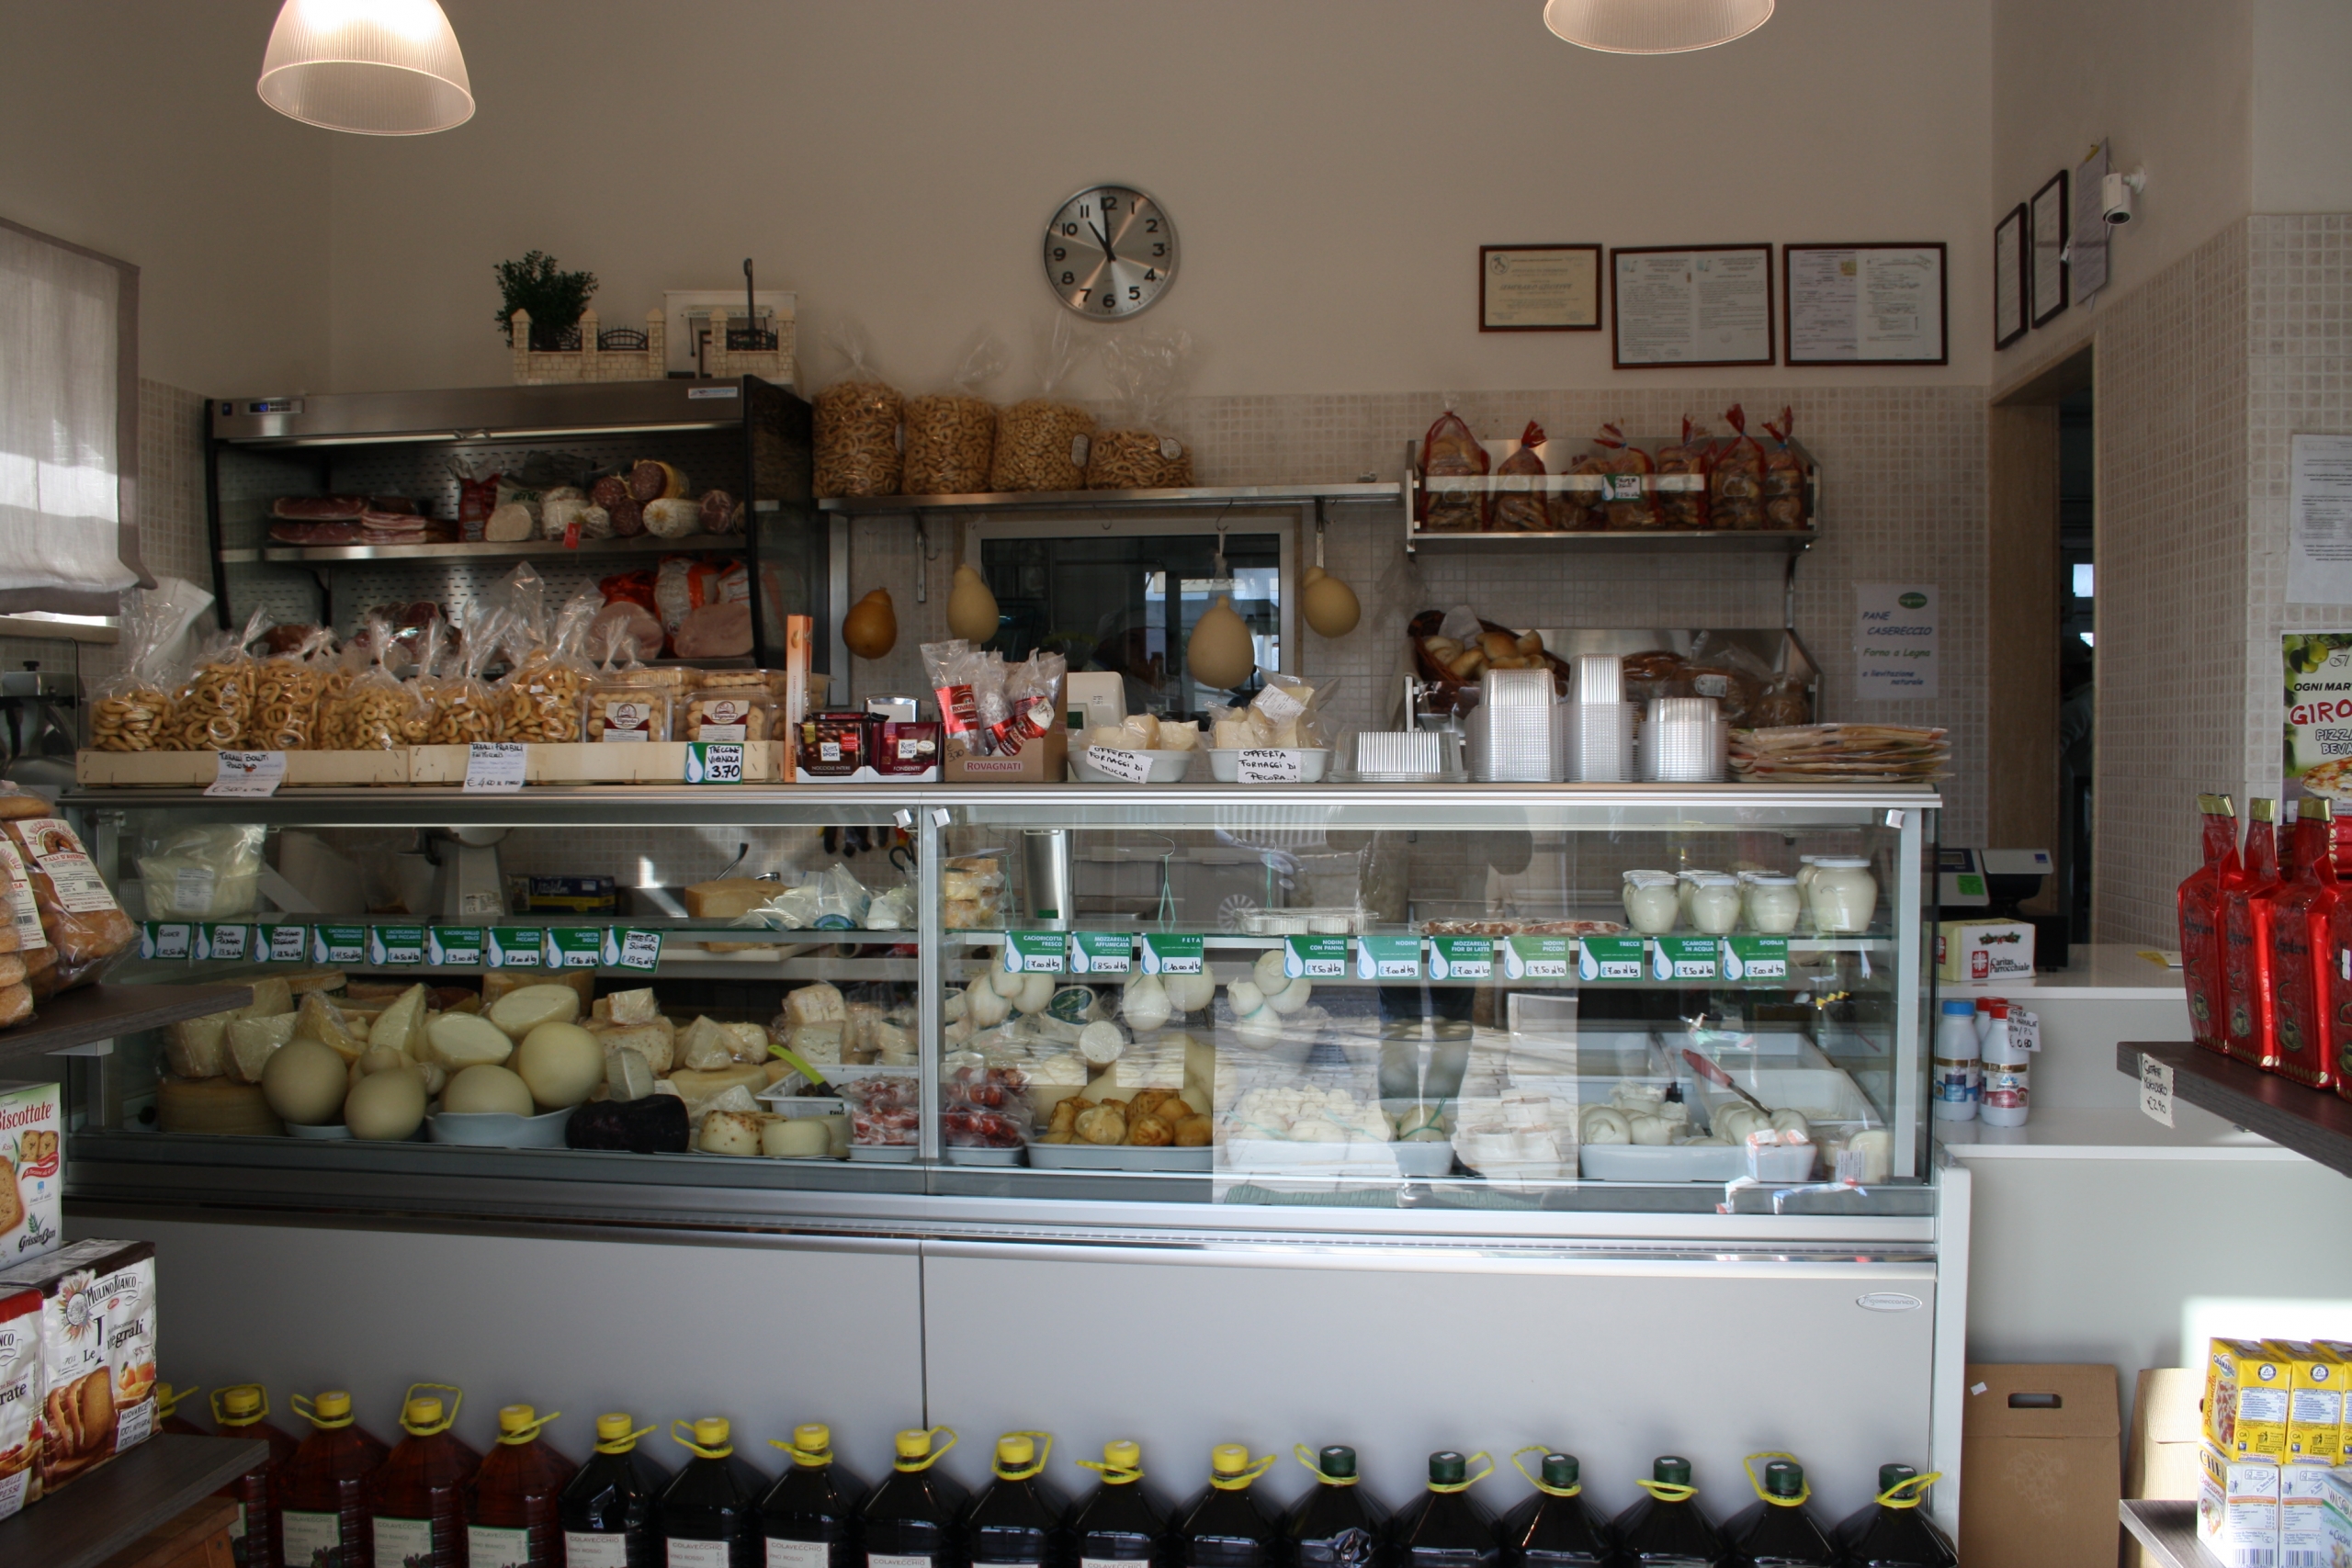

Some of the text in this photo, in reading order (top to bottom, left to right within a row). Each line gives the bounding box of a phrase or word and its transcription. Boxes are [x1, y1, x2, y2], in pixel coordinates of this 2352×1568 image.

[1101, 196, 1118, 210] 12
[1080, 205, 1090, 218] 11
[1062, 222, 1078, 236] 10
[1146, 219, 1159, 232] 2
[1053, 247, 1066, 261] 9
[1152, 243, 1165, 257] 3
[1061, 271, 1075, 285] 8
[1144, 267, 1156, 282] 4
[1080, 288, 1091, 302] 7
[1128, 286, 1140, 300] 5
[1102, 293, 1115, 308] 6
[1862, 611, 1891, 621] PANE
[1867, 626, 1933, 636] CASERECCIO
[1863, 648, 1890, 657] Forno
[1904, 649, 1931, 659] Legna
[2293, 682, 2352, 692] OGNI MAR
[1094, 747, 1134, 760] OFFERTA
[1243, 750, 1286, 759] OFFERTA
[711, 765, 741, 779] 3.70
[967, 762, 1021, 771] ROVAGNATI
[0, 848, 23, 870] ORNO
[1989, 962, 2030, 973] Parrocchiale
[1991, 957, 2014, 965] Caritas
[84, 1348, 96, 1363] Le
[0, 1383, 27, 1405] rate
[2328, 1488, 2352, 1517] VALSO
[377, 1521, 424, 1529] COLAVECCHIO
[473, 1530, 522, 1540] COLAVECCHIO
[673, 1541, 723, 1551] COLAVECCHIO
[771, 1541, 822, 1552] COLAVECCHIO
[873, 1558, 925, 1566] COLAVECCHIO
